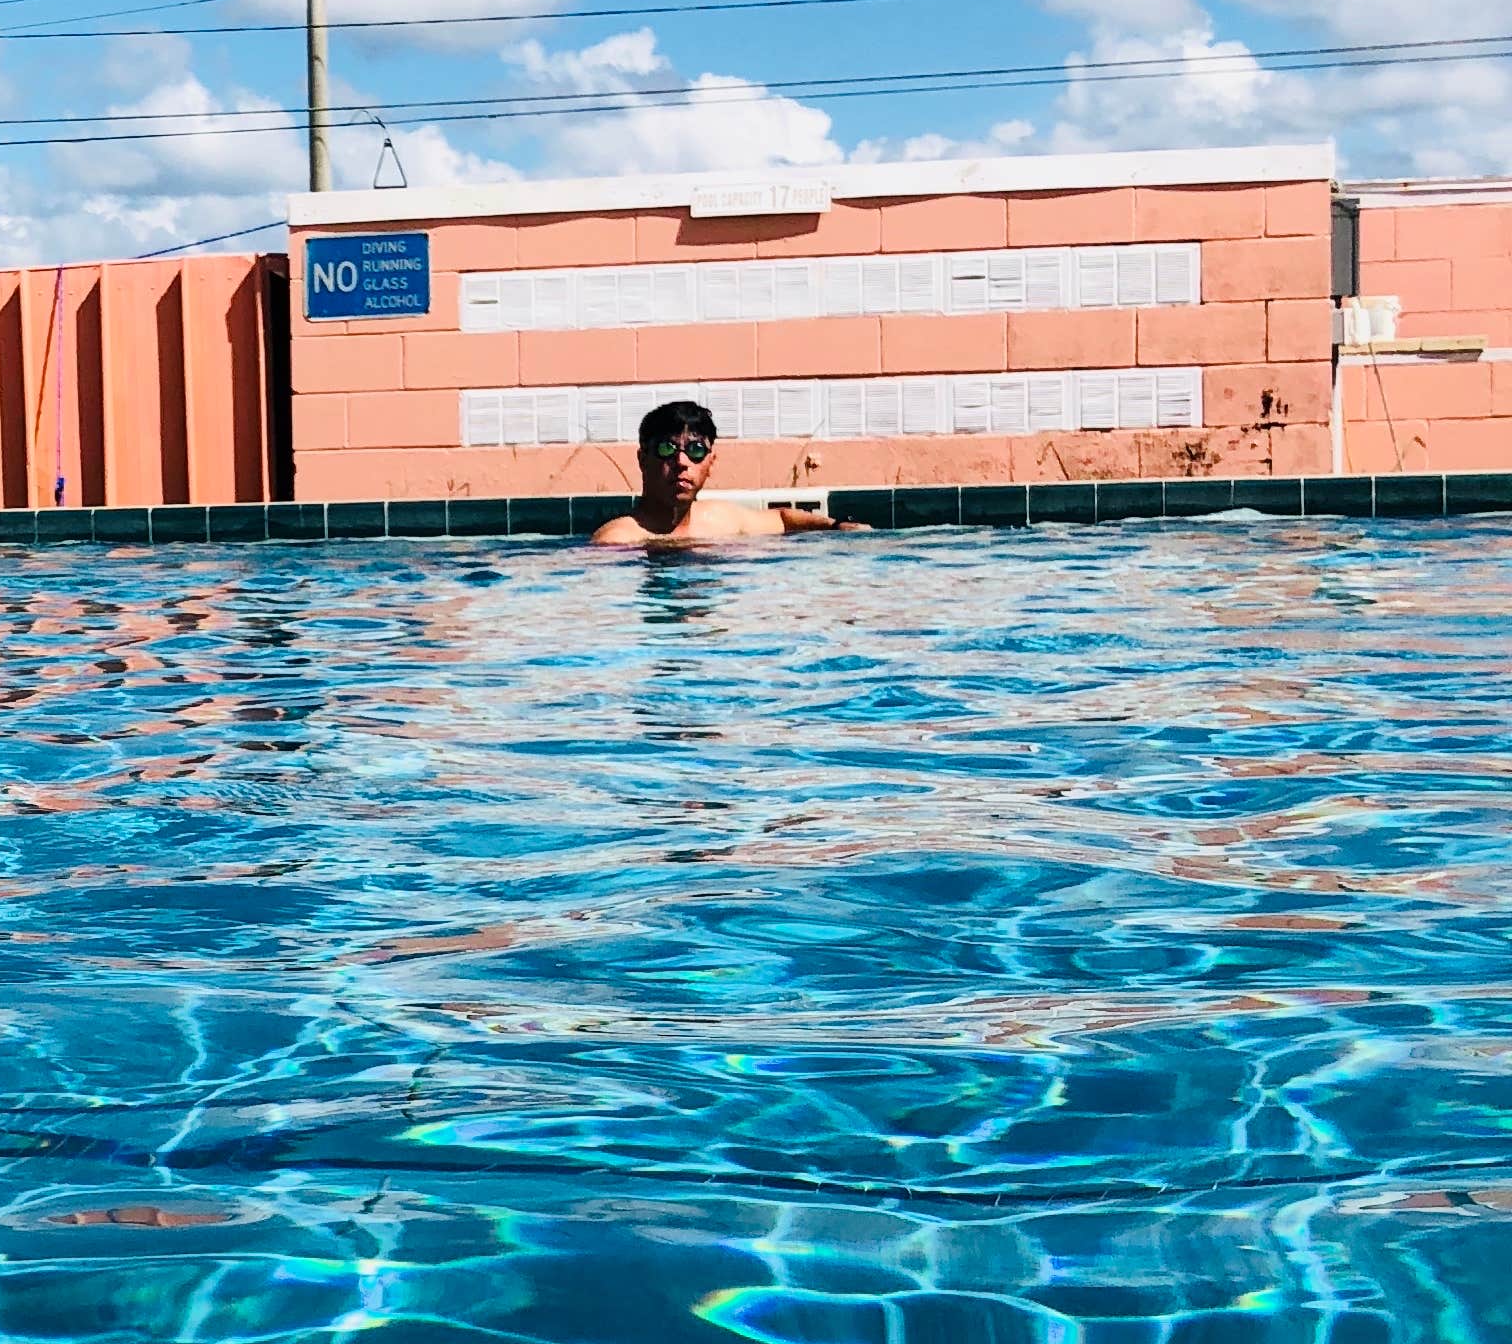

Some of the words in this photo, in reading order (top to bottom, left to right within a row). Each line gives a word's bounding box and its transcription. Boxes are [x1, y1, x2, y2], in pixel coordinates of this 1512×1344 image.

[769, 184, 790, 209] 17
[362, 240, 407, 255] DIVING
[362, 258, 422, 273] RUNNING
[313, 260, 358, 293] NO
[363, 276, 408, 291] GLASS
[364, 294, 421, 309] ALCOHOL
